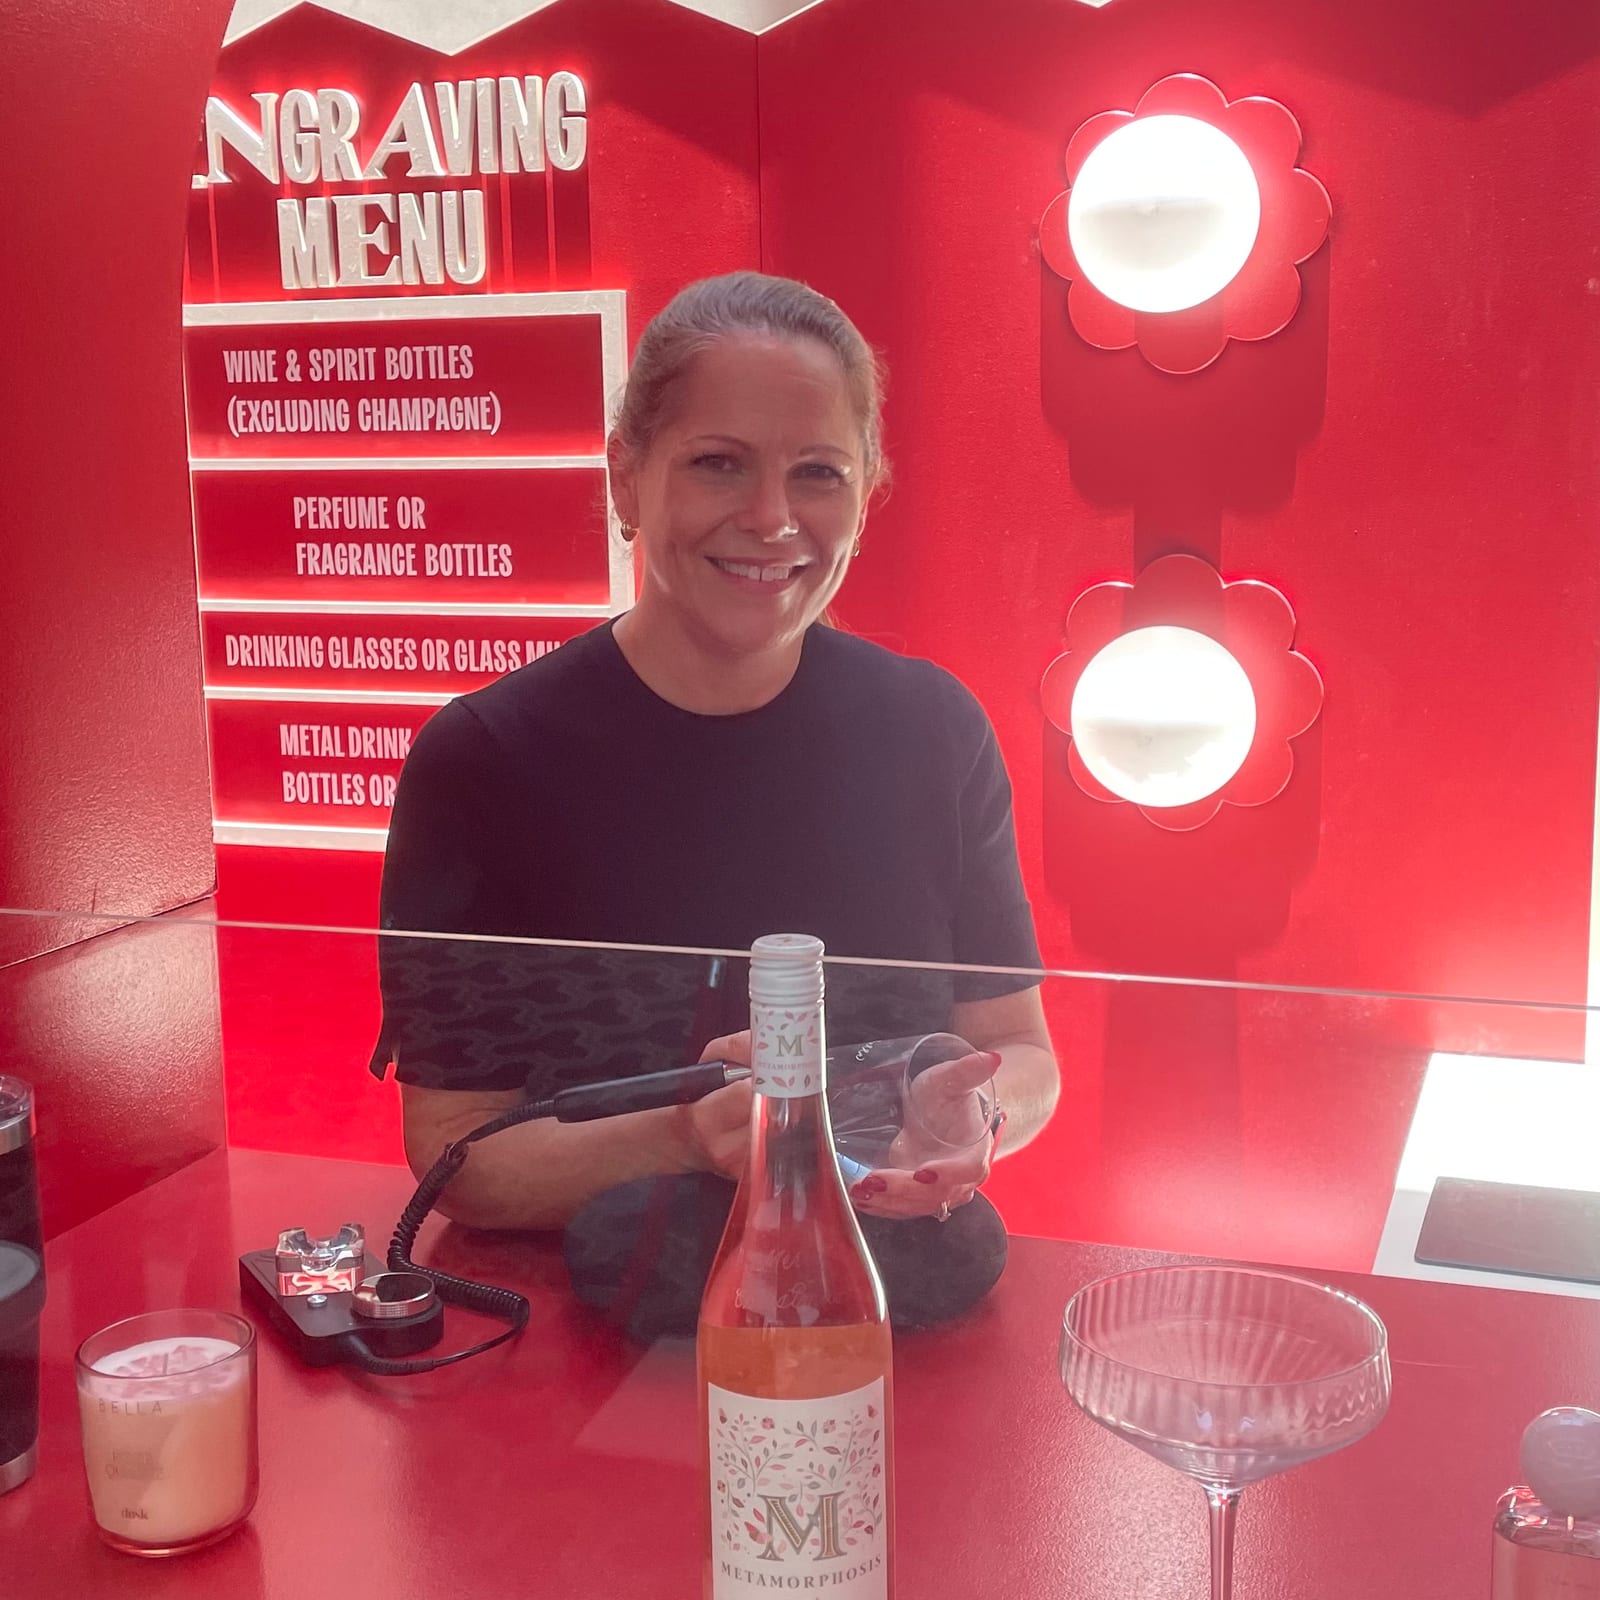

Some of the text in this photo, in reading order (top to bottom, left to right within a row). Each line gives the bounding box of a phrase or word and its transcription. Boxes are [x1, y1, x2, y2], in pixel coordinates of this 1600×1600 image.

[191, 70, 588, 189] NGRAVING
[276, 189, 486, 290] MENU
[223, 345, 474, 383] WINE & SPIRIT BOTTLES
[227, 391, 502, 437] (EXCLUDING CHAMPAGNE)
[293, 496, 426, 530] PERFUME OR
[296, 543, 513, 577] FRAGRANCE BOTTLES
[225, 635, 324, 668] DRINKING
[328, 637, 418, 670] GLASSES
[421, 639, 450, 671] OR
[454, 639, 521, 672] GLASS
[279, 724, 345, 757] METAL
[282, 771, 396, 807] BOTTLES OR
[776, 1034, 804, 1057] M
[98, 1398, 162, 1416] BELLA
[756, 1491, 847, 1561] M
[721, 1555, 881, 1589] METAMORPHOSIS
